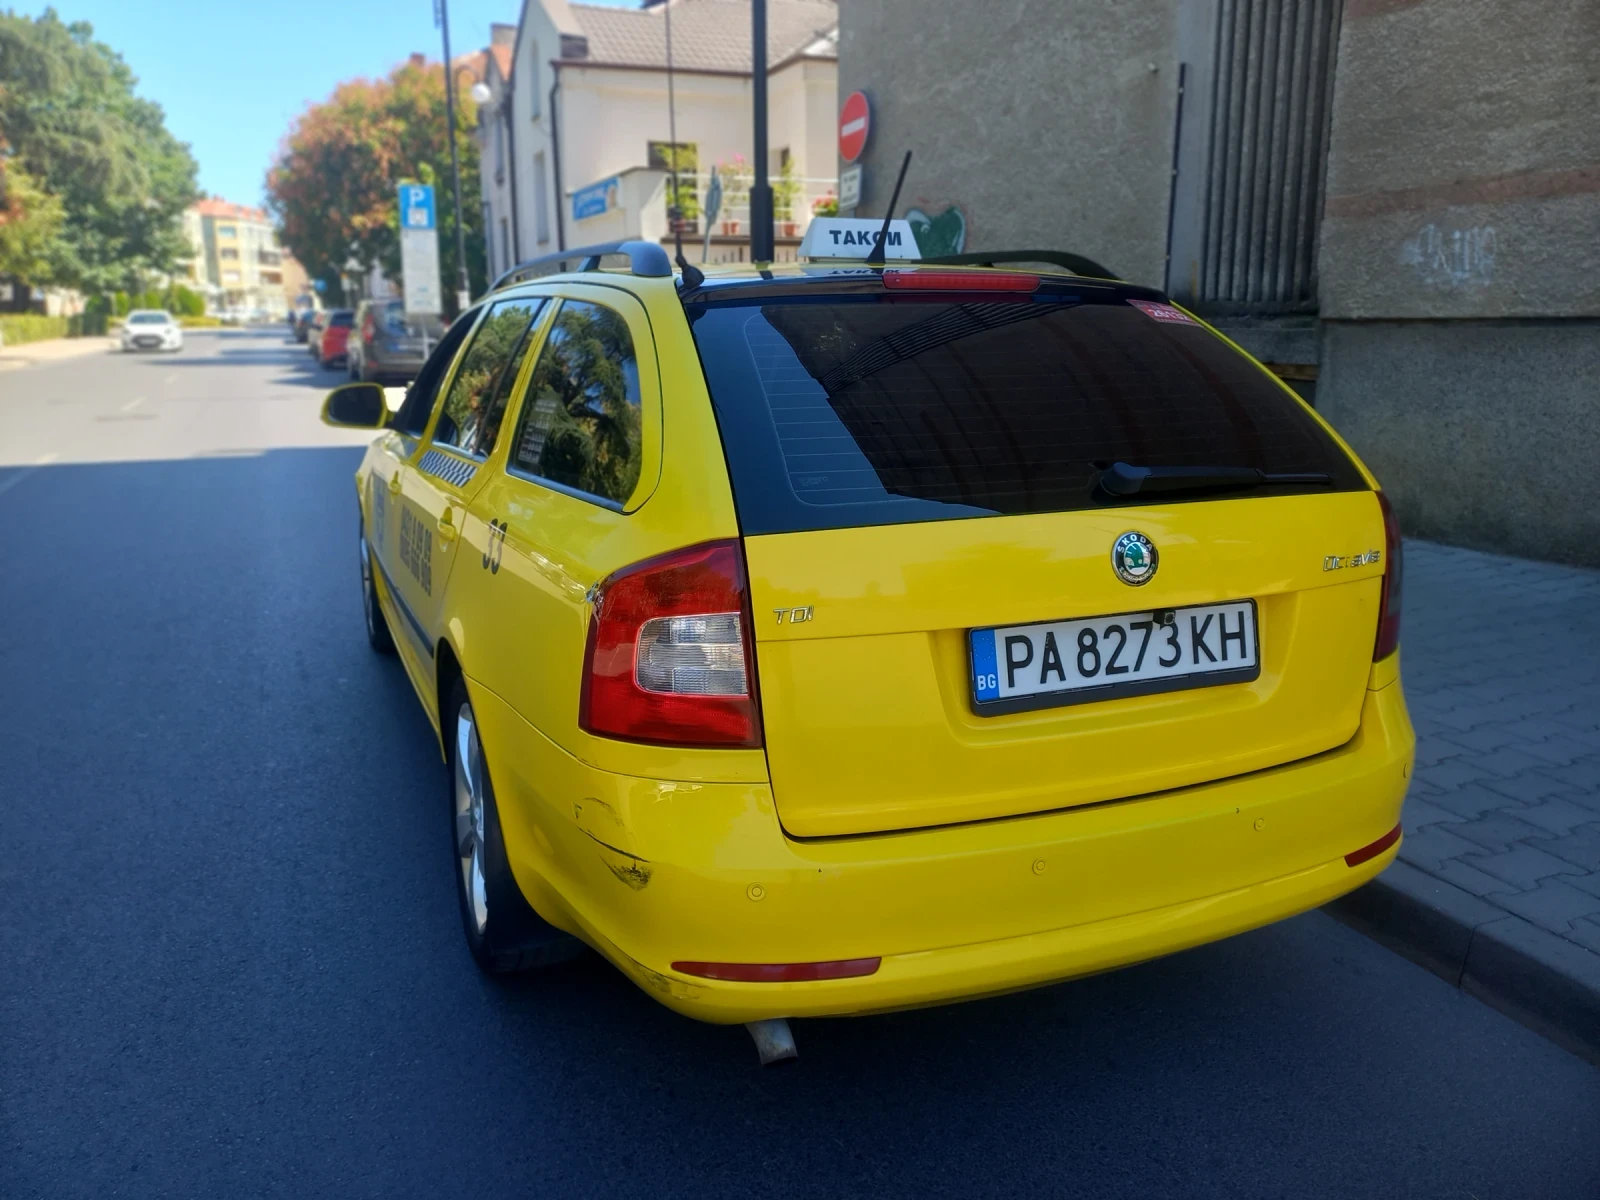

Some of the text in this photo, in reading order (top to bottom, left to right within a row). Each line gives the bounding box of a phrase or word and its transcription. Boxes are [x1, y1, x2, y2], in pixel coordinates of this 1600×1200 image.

[773, 605, 814, 624] TDI
[1077, 620, 1182, 678] 8273
[977, 674, 997, 691] BG
